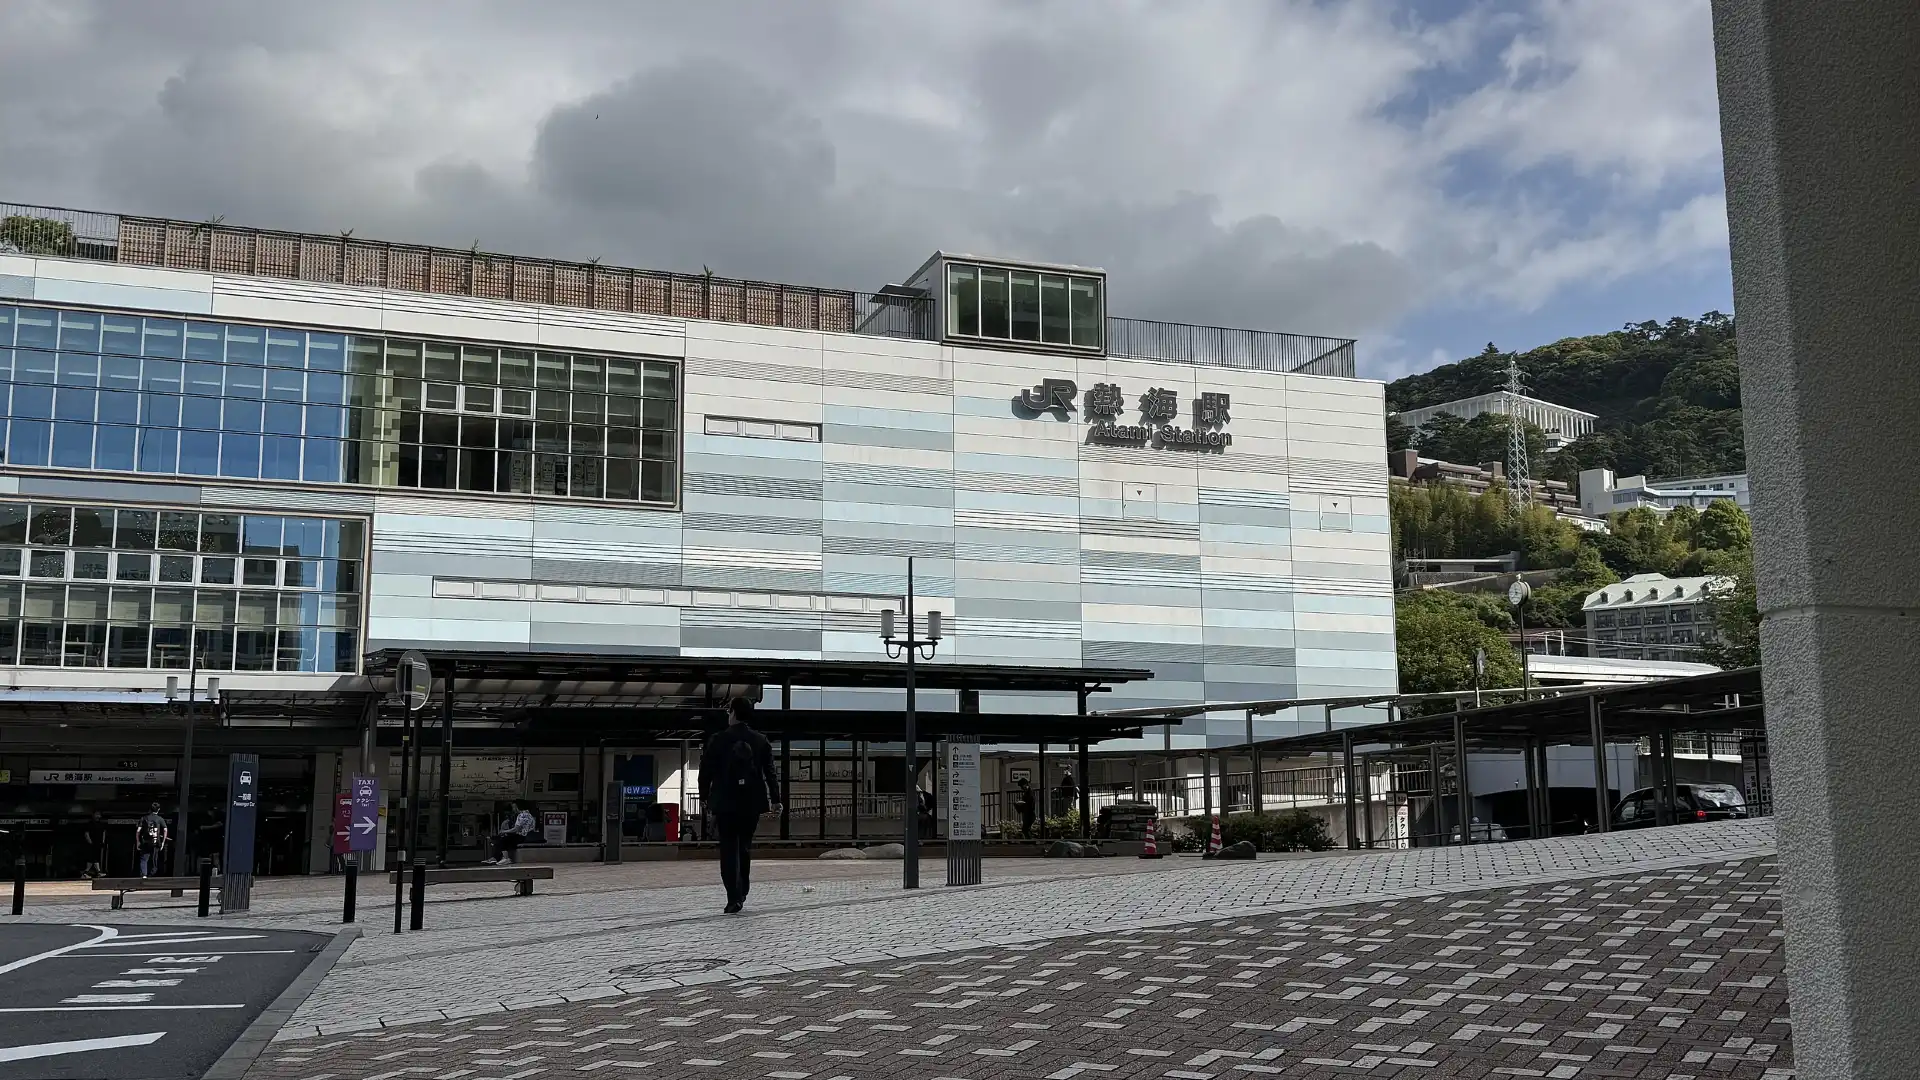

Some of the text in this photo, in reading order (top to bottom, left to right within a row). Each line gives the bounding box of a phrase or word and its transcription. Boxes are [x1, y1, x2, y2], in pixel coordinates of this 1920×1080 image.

[1020, 377, 1232, 425] JR 熱海駅
[1094, 420, 1233, 447] Atami Station
[44, 773, 59, 782] JR
